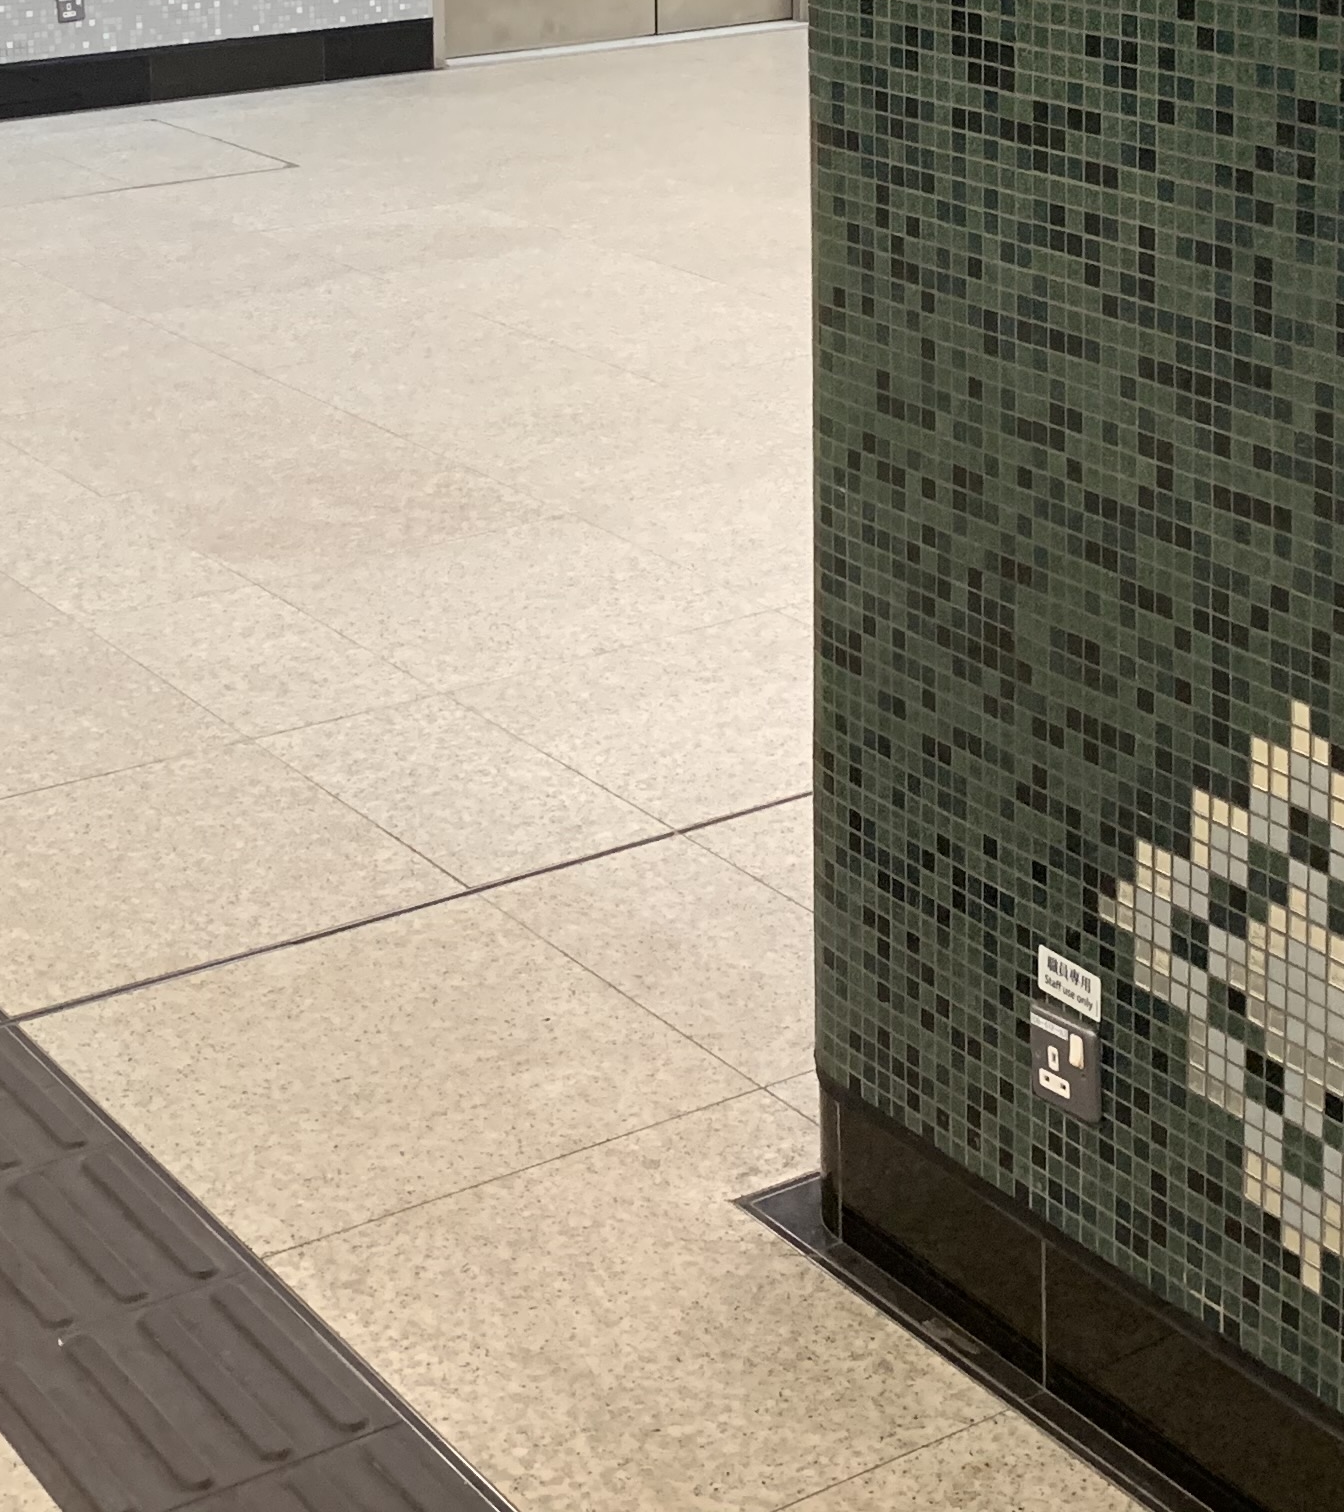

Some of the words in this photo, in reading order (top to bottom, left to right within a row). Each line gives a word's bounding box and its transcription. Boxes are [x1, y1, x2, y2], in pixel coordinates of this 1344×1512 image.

[1044, 974, 1062, 992] Staff
[1062, 986, 1076, 1000] use
[1076, 994, 1093, 1012] only
